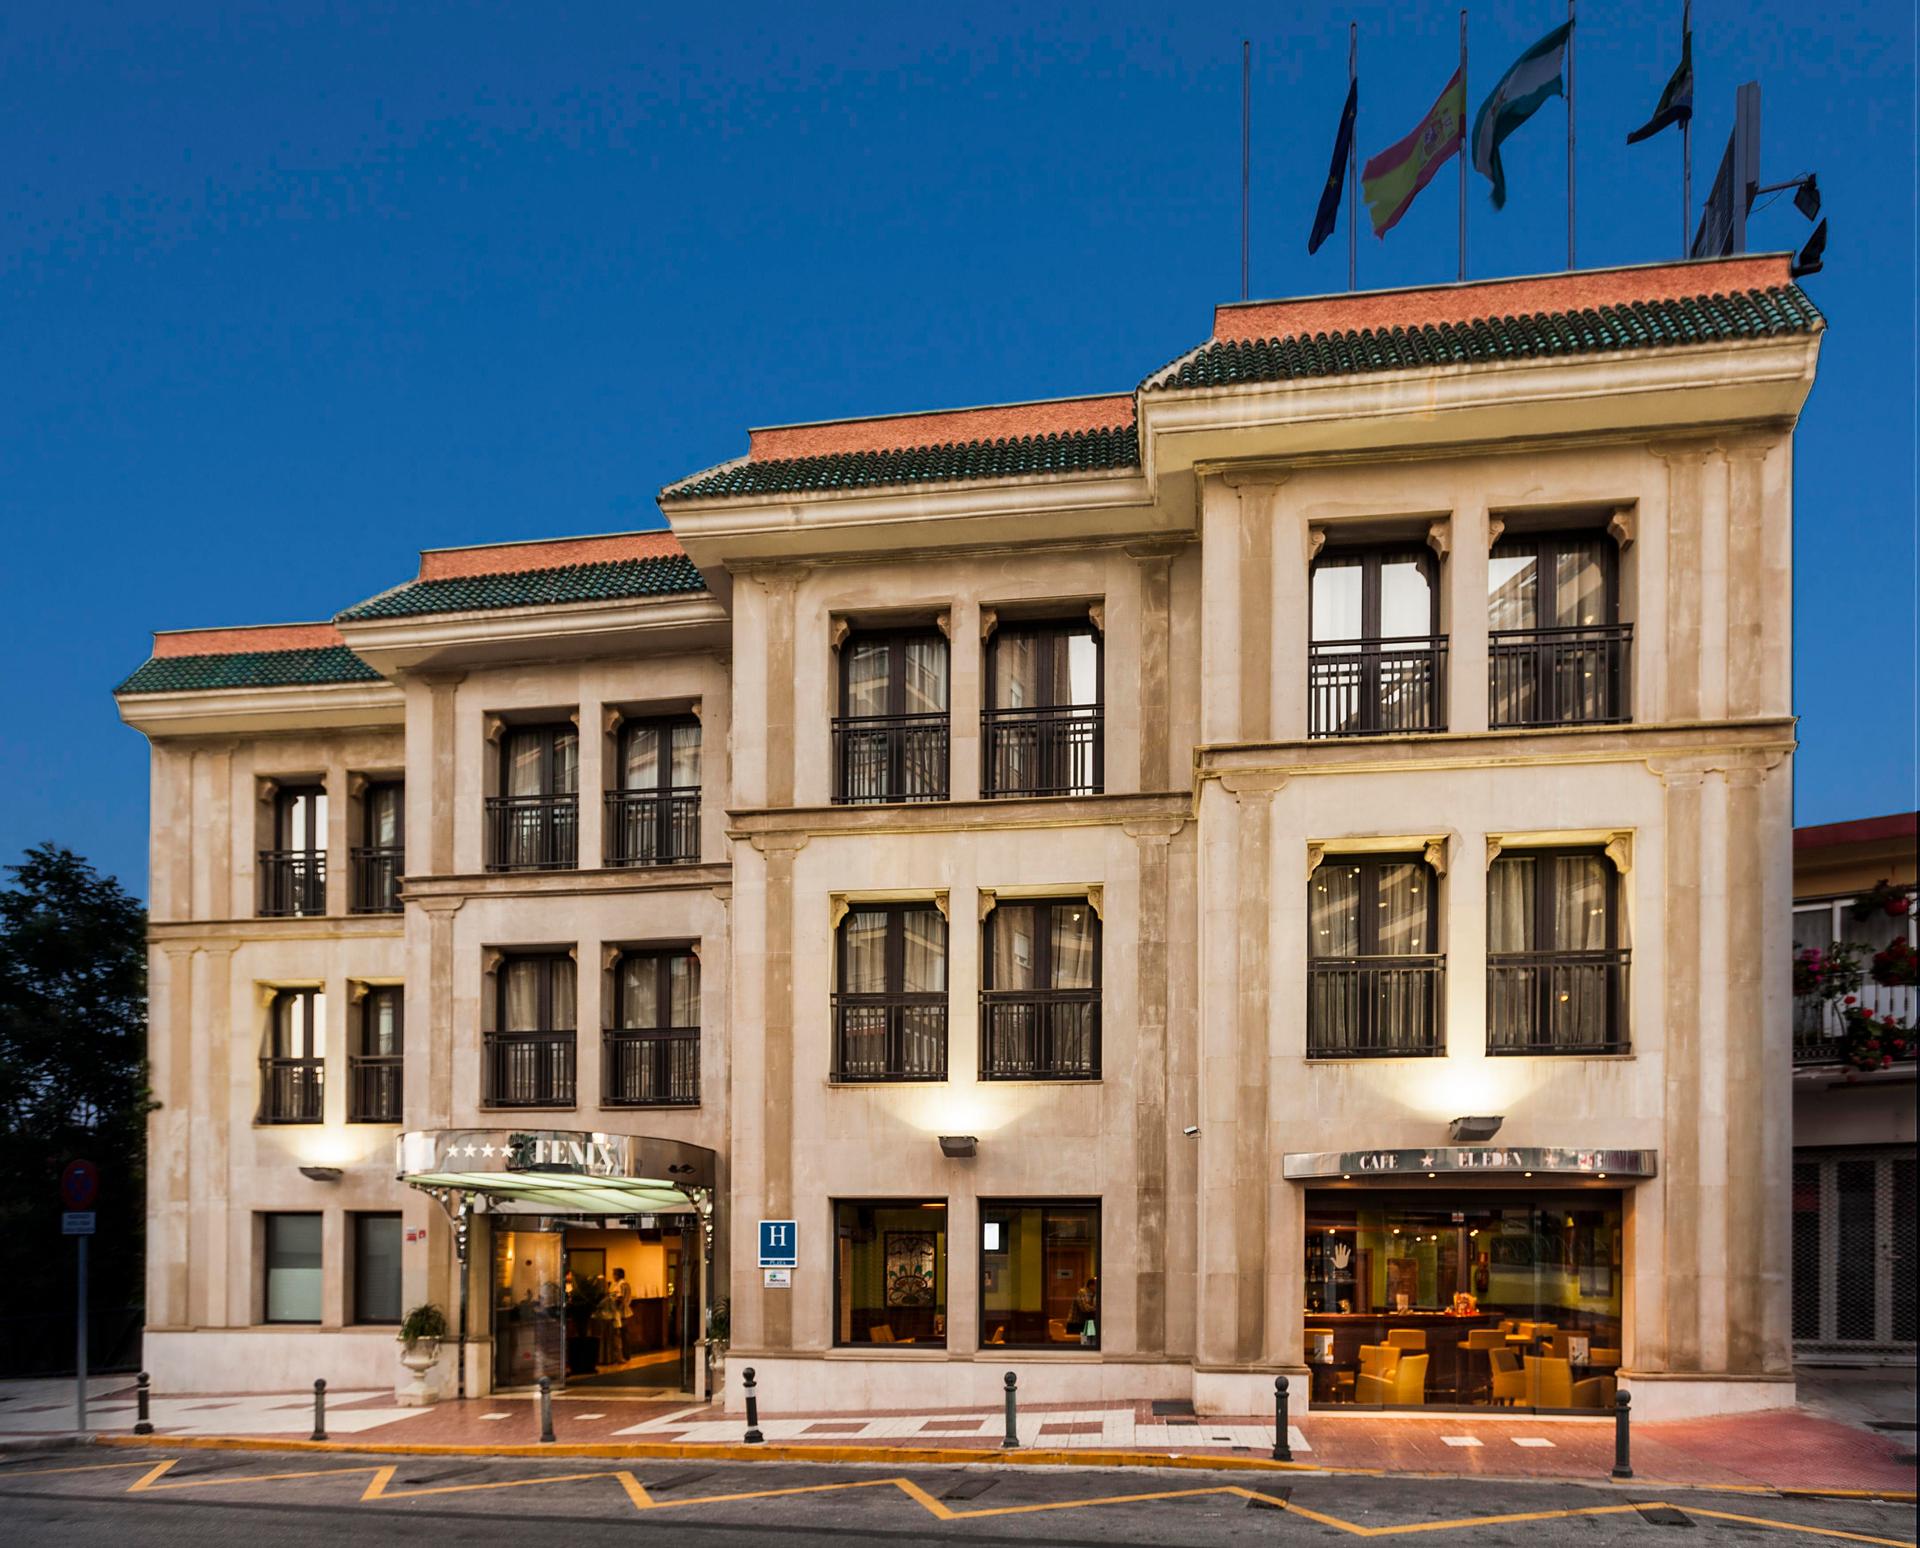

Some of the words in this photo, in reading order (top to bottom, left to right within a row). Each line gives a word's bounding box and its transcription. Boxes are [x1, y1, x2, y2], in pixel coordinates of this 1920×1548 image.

[535, 1139, 614, 1168] FENIX
[1458, 1152, 1478, 1168] EL
[768, 1225, 787, 1247] H
